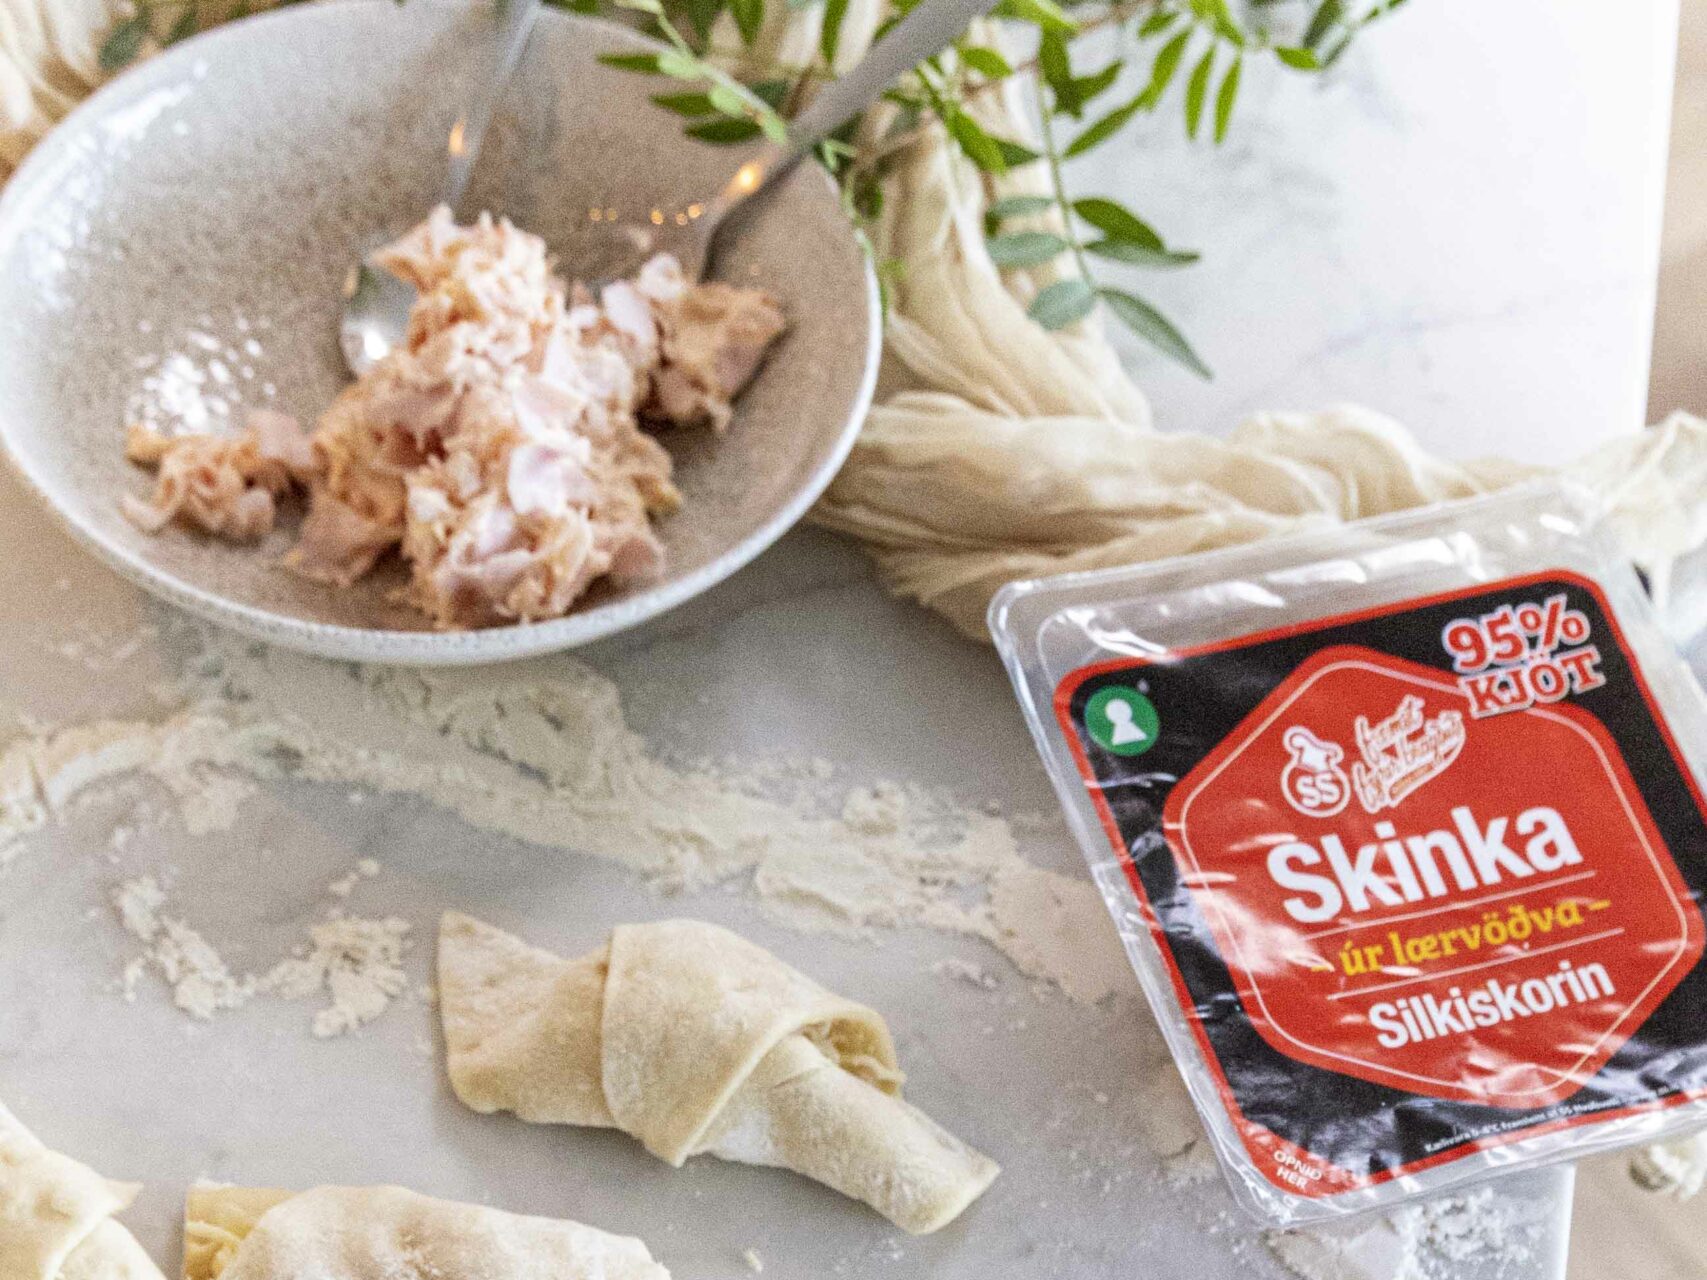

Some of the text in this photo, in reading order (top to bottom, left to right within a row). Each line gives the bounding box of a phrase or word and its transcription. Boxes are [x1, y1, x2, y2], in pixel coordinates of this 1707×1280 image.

[1444, 596, 1590, 671] 95%
[1460, 648, 1605, 717] KJÖT
[1296, 774, 1342, 808] SS
[1267, 806, 1584, 923] Skinka
[1339, 901, 1584, 977] úr lærvöðva
[1369, 959, 1617, 1049] Silkiskorin
